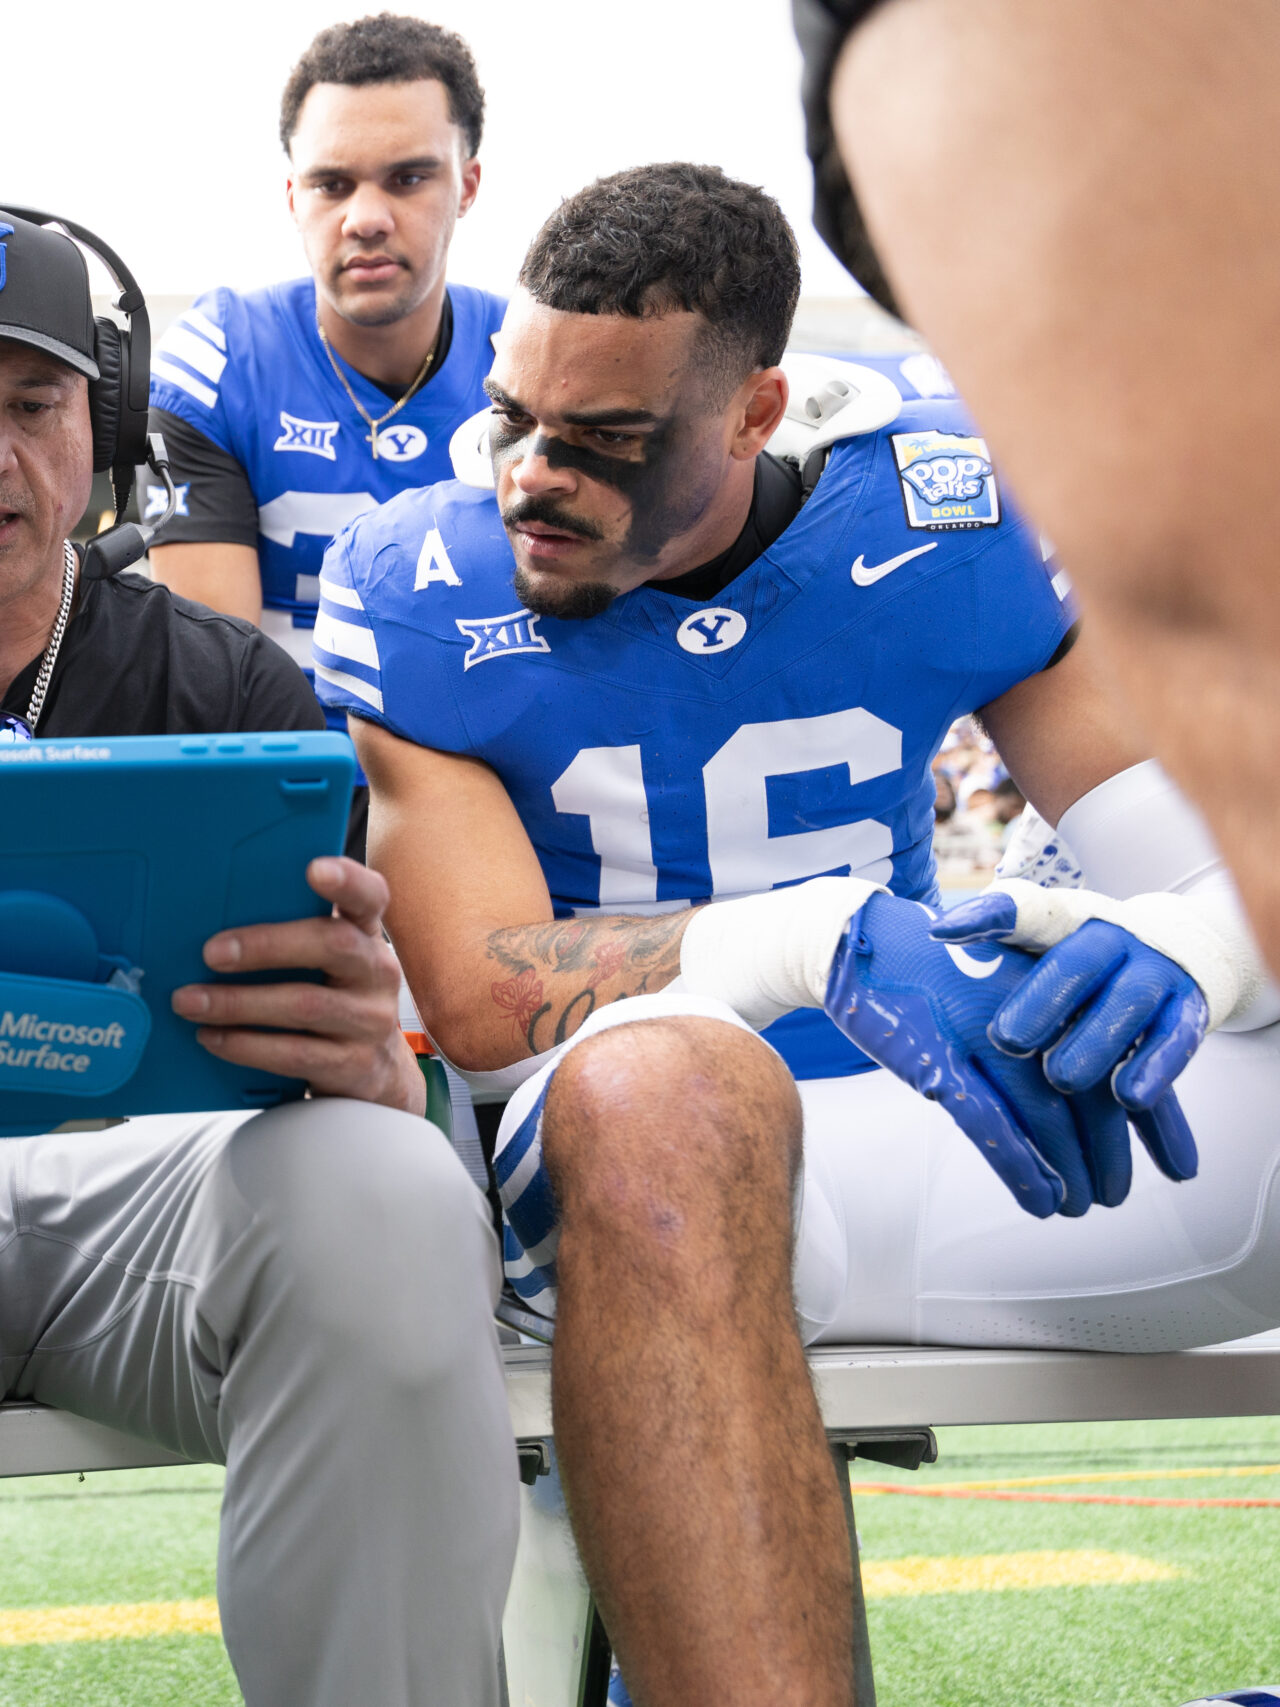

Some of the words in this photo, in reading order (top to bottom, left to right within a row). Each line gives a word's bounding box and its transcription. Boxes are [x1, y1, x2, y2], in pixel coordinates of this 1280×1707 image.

[931, 505, 975, 518] BOWL
[930, 522, 980, 530] ORLANDO
[414, 527, 463, 592] A
[45, 744, 111, 761] Surface
[551, 706, 903, 917] 16
